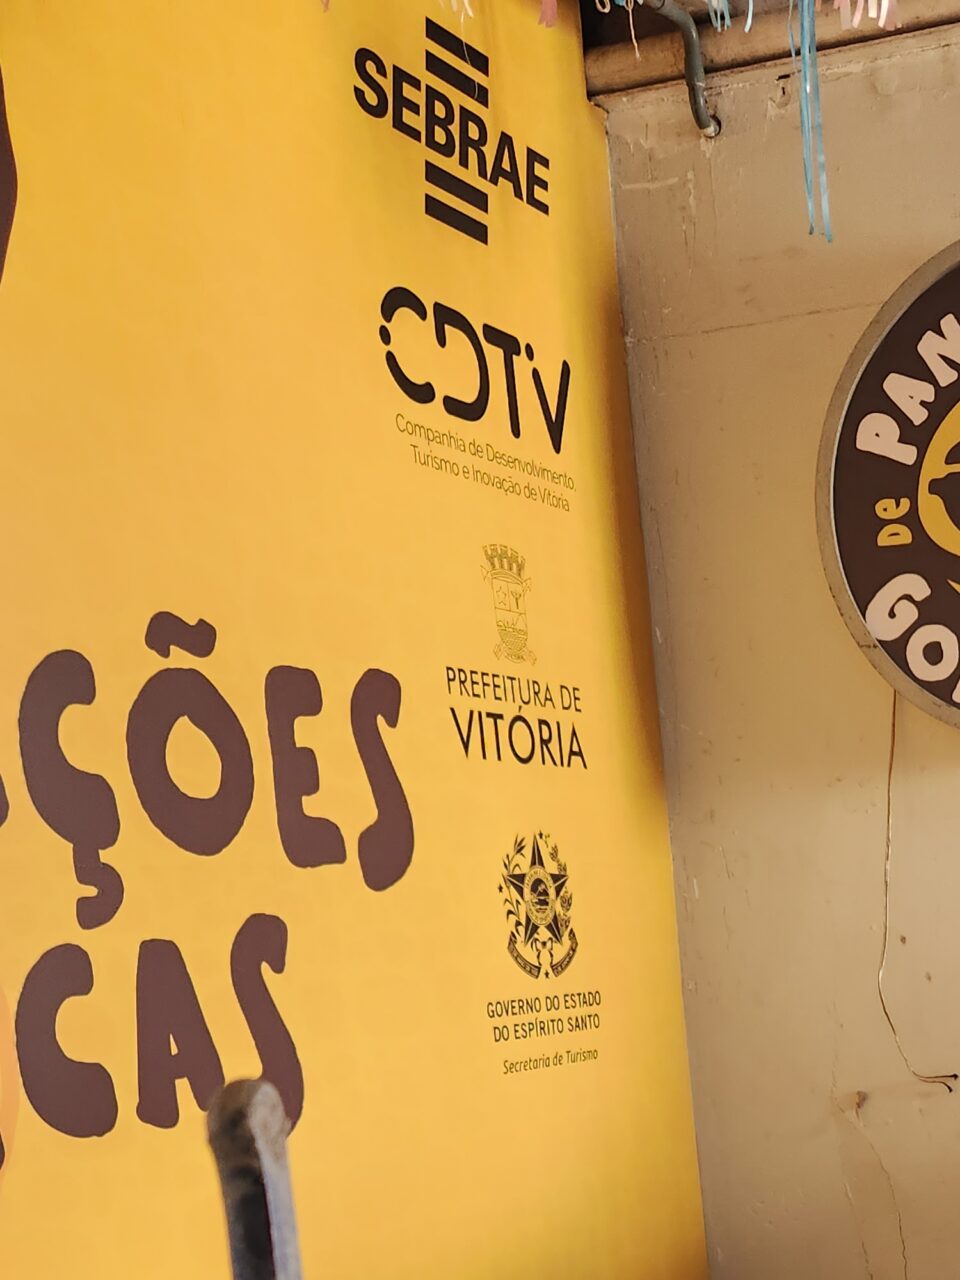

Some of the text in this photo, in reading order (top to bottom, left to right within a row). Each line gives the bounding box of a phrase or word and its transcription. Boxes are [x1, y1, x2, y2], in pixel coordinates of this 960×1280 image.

[353, 46, 550, 215] SEBRAE
[395, 413, 466, 453] Companhia
[468, 439, 484, 458] de
[409, 443, 460, 476] Turismo
[462, 466, 470, 479] e
[472, 464, 522, 496] Inovação
[523, 482, 538, 501] de
[445, 666, 582, 712] PREFEITURA DE
[450, 705, 588, 769] VITÓRIA
[0, 610, 415, 930] ÇÕES
[487, 990, 601, 1018] GOVERNO DO ESTADO
[493, 1013, 600, 1043] DO ESPÍRITO SANTO
[503, 1048, 598, 1075] Secretaria de Turismo
